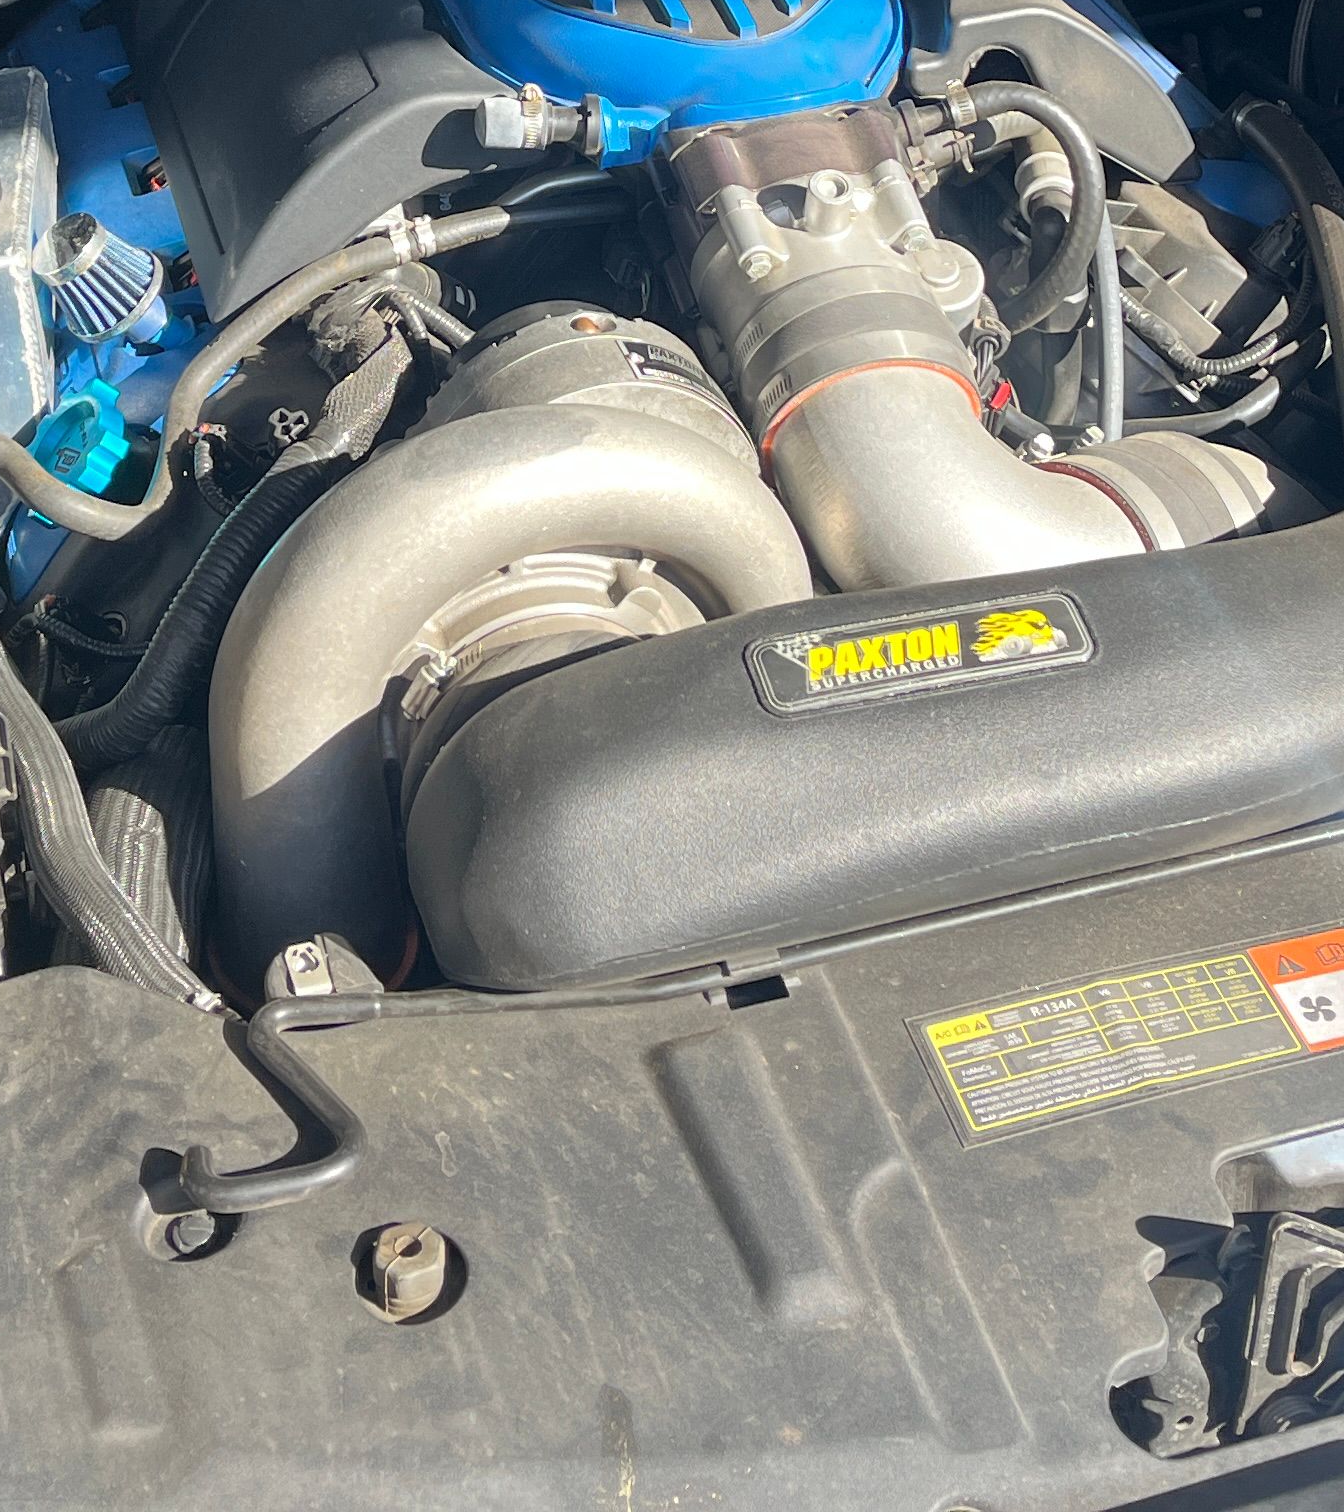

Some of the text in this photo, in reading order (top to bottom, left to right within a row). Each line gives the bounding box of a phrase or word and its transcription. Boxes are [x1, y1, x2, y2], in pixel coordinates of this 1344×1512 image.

[808, 623, 959, 680] PAXTON
[810, 657, 960, 692] SUPERCHARGED
[1029, 998, 1077, 1017] R-134A
